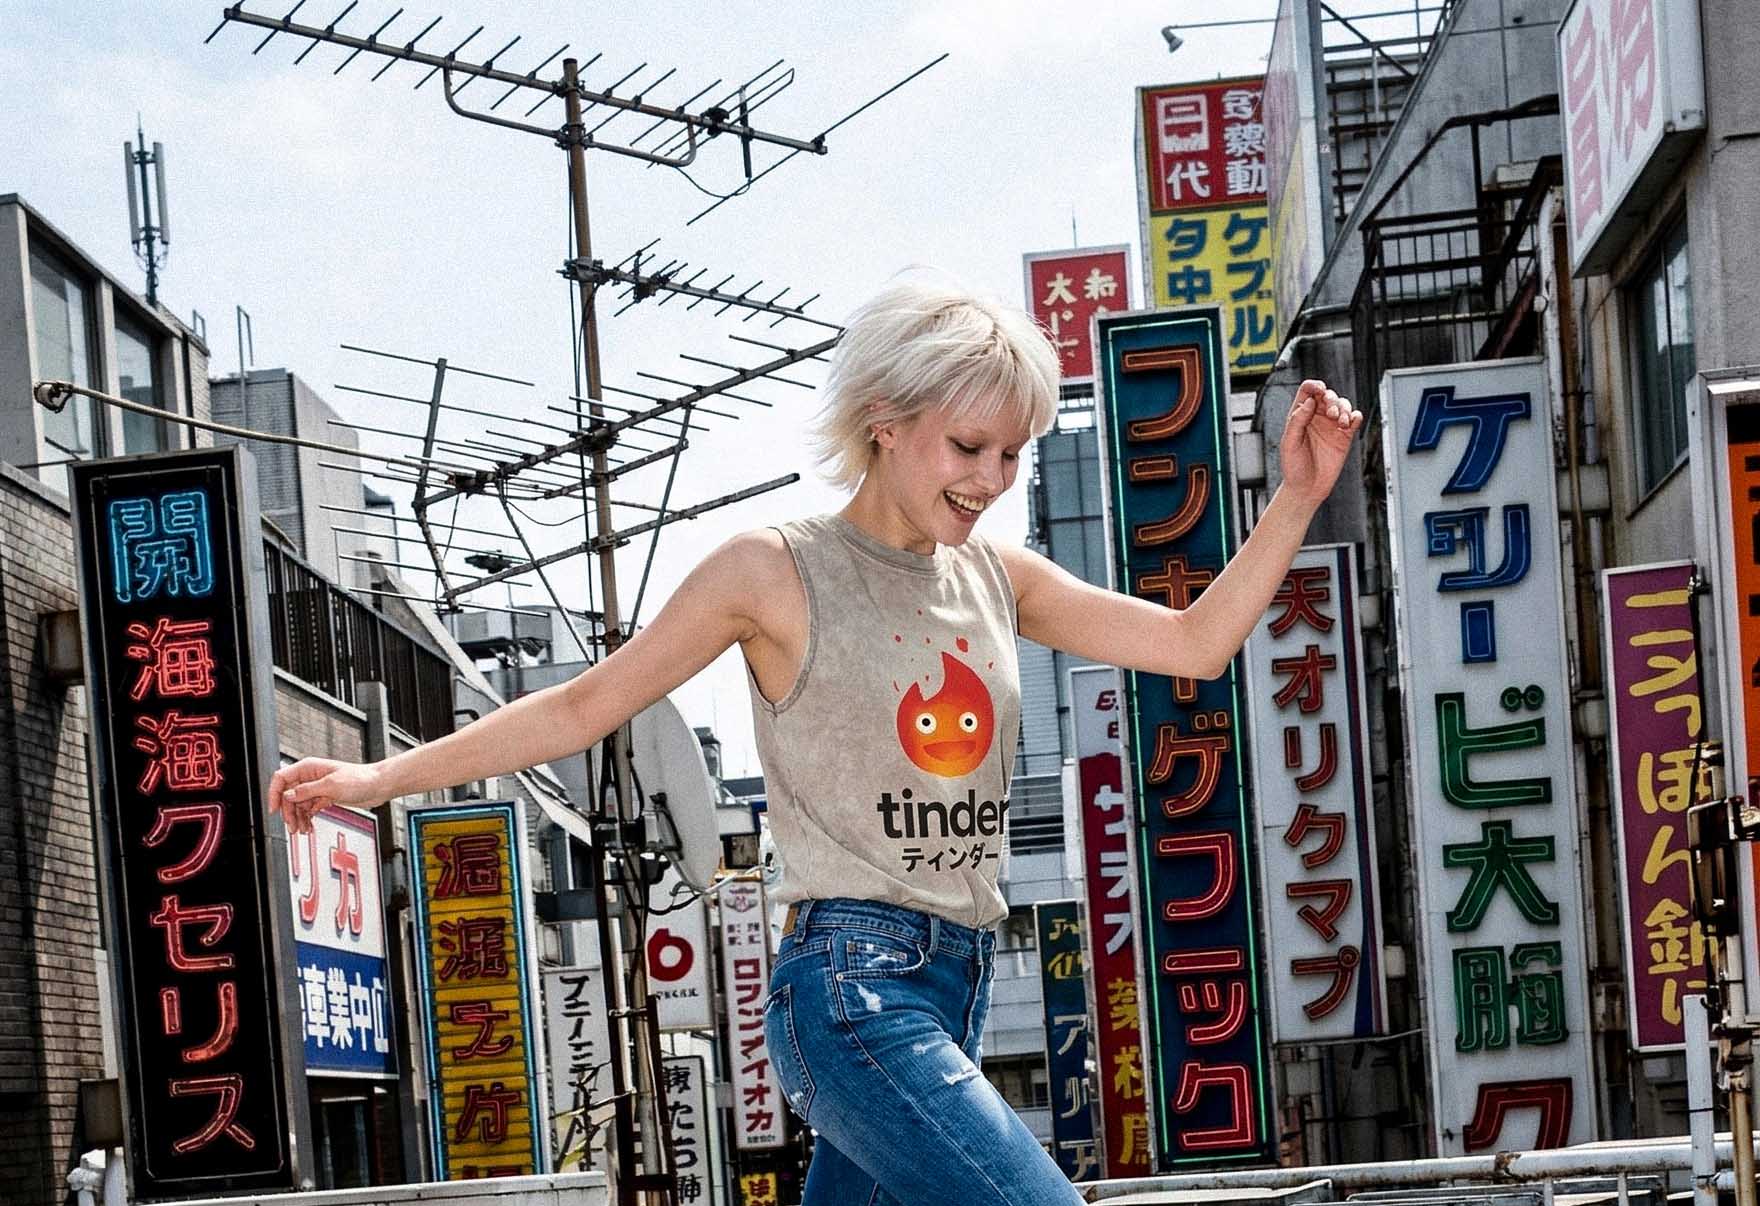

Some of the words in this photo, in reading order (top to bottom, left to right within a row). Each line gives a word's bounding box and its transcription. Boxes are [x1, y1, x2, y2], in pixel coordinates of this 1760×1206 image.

[877, 788, 1010, 839] tinder
[901, 842, 998, 873] ティンダー
